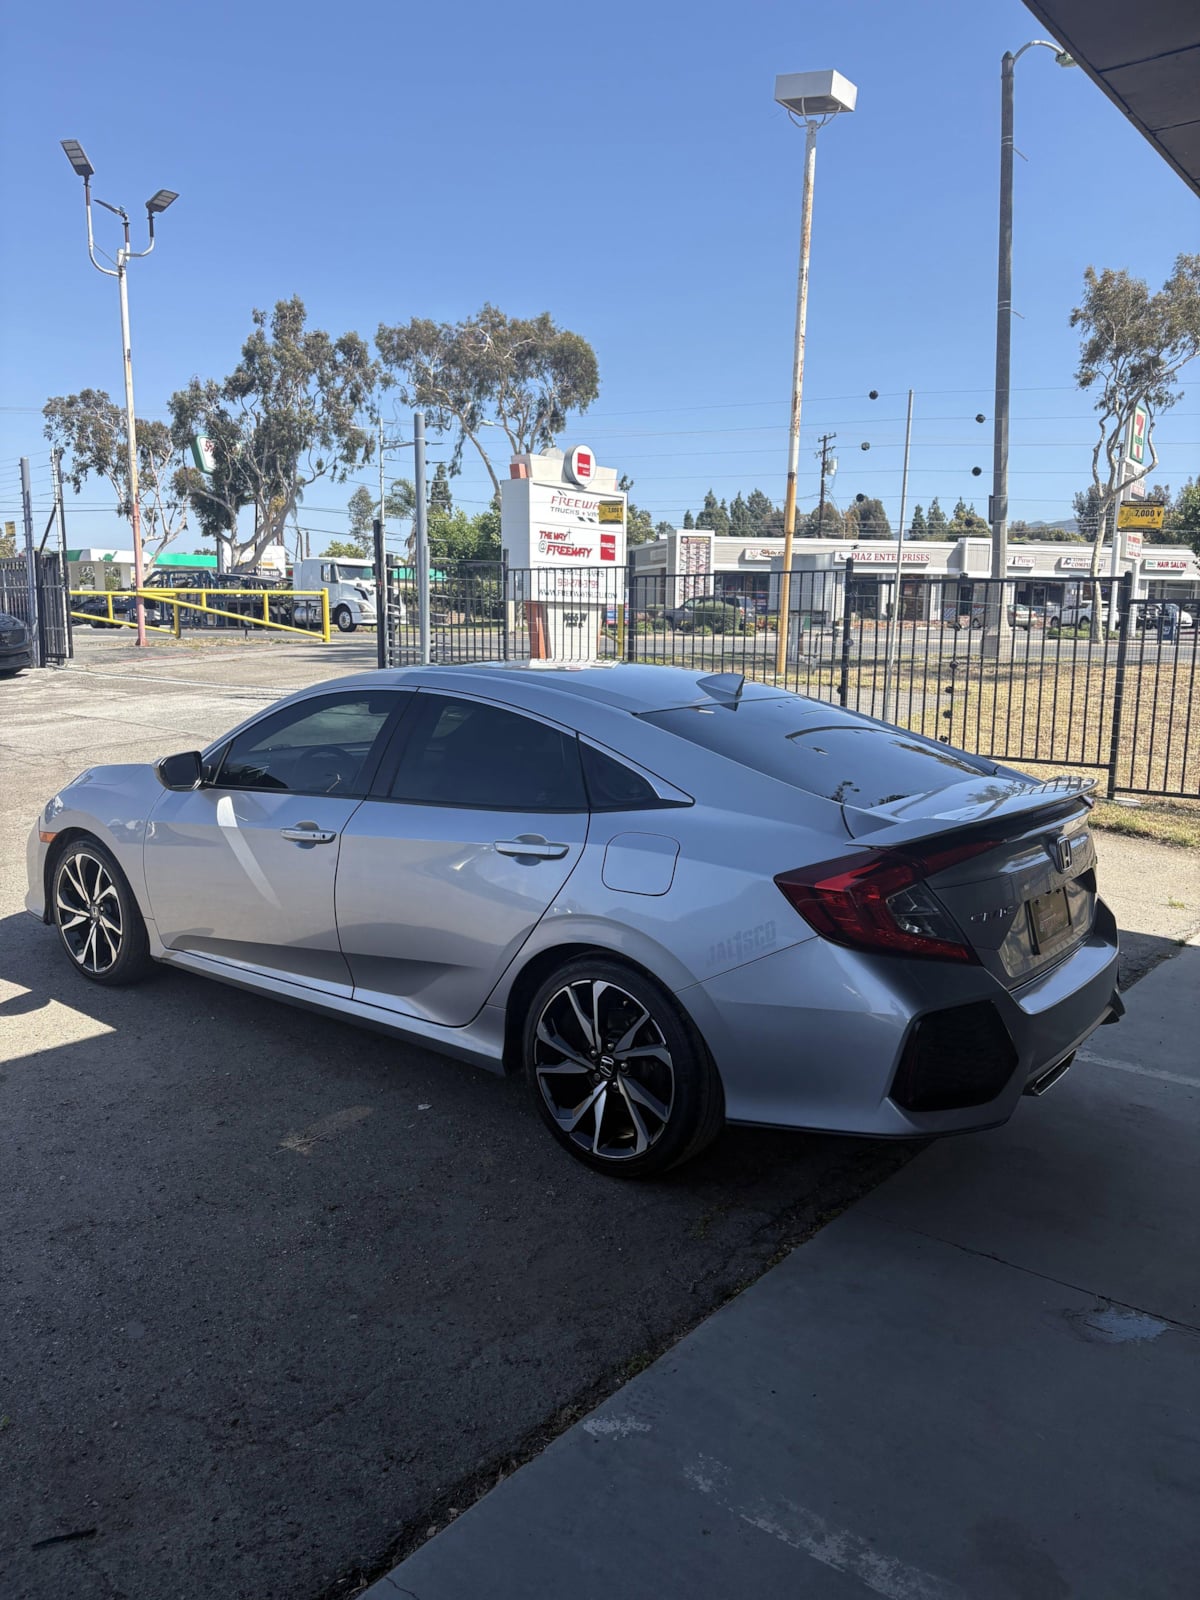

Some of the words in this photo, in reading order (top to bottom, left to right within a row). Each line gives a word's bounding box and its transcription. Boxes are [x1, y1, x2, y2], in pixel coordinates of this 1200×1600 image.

[551, 496, 600, 510] FREEWA
[550, 506, 580, 516] TRUCKS
[1135, 509, 1155, 519] 7,000
[539, 530, 553, 540] THE
[553, 532, 568, 541] WAY
[851, 552, 872, 561] DIAZ
[874, 553, 930, 562] ENTEPRISES
[706, 920, 776, 967] JALISCO
